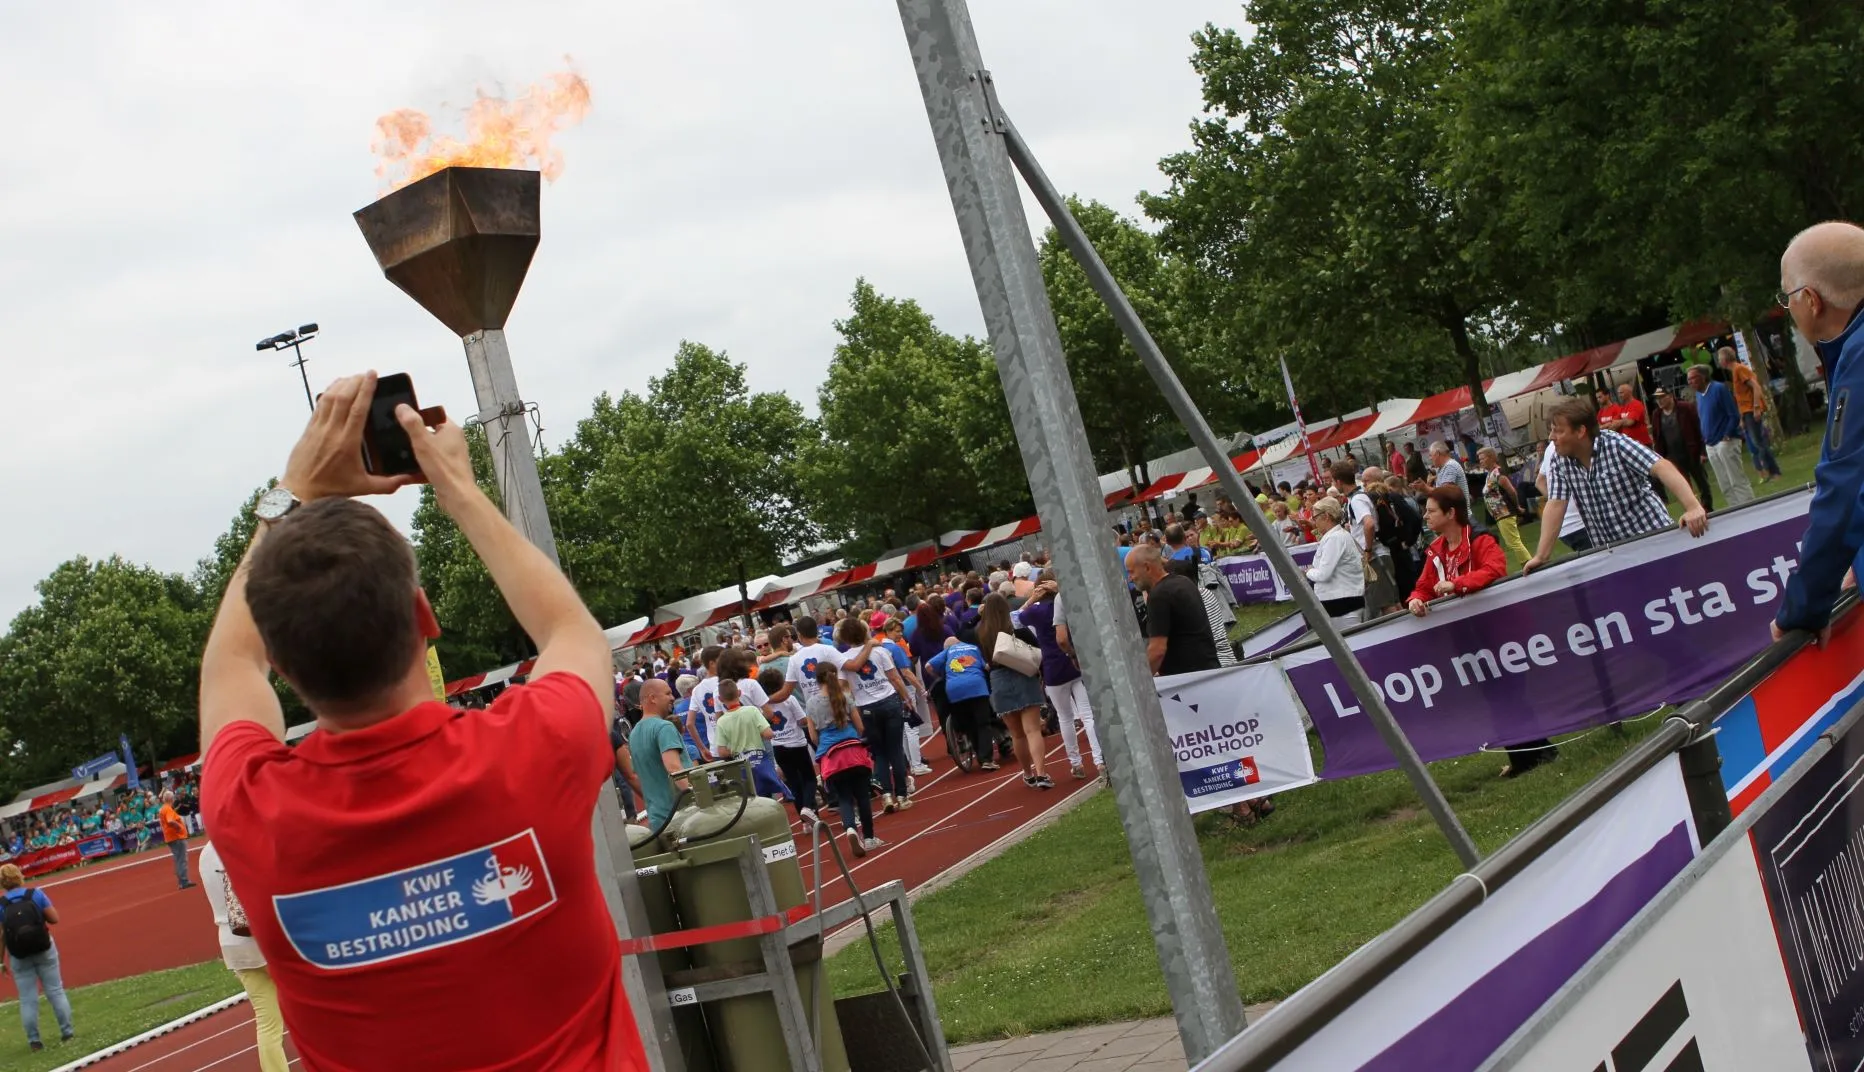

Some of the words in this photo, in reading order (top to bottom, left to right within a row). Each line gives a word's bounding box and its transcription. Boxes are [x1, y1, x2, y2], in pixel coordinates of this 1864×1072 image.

[1451, 632, 1558, 687] mee
[1566, 610, 1634, 657] en
[1643, 579, 1737, 636] sta
[1217, 733, 1264, 753] HOOP
[1211, 765, 1229, 775] KWF
[1202, 773, 1231, 784] KANKER
[1192, 781, 1234, 795] BESTRIJDING
[772, 847, 789, 859] Piet
[636, 868, 655, 877] Gas
[402, 868, 456, 897] KWF
[369, 890, 464, 929] KANKER
[326, 912, 470, 960] BESTRIJDING
[674, 992, 694, 1003] Gas
